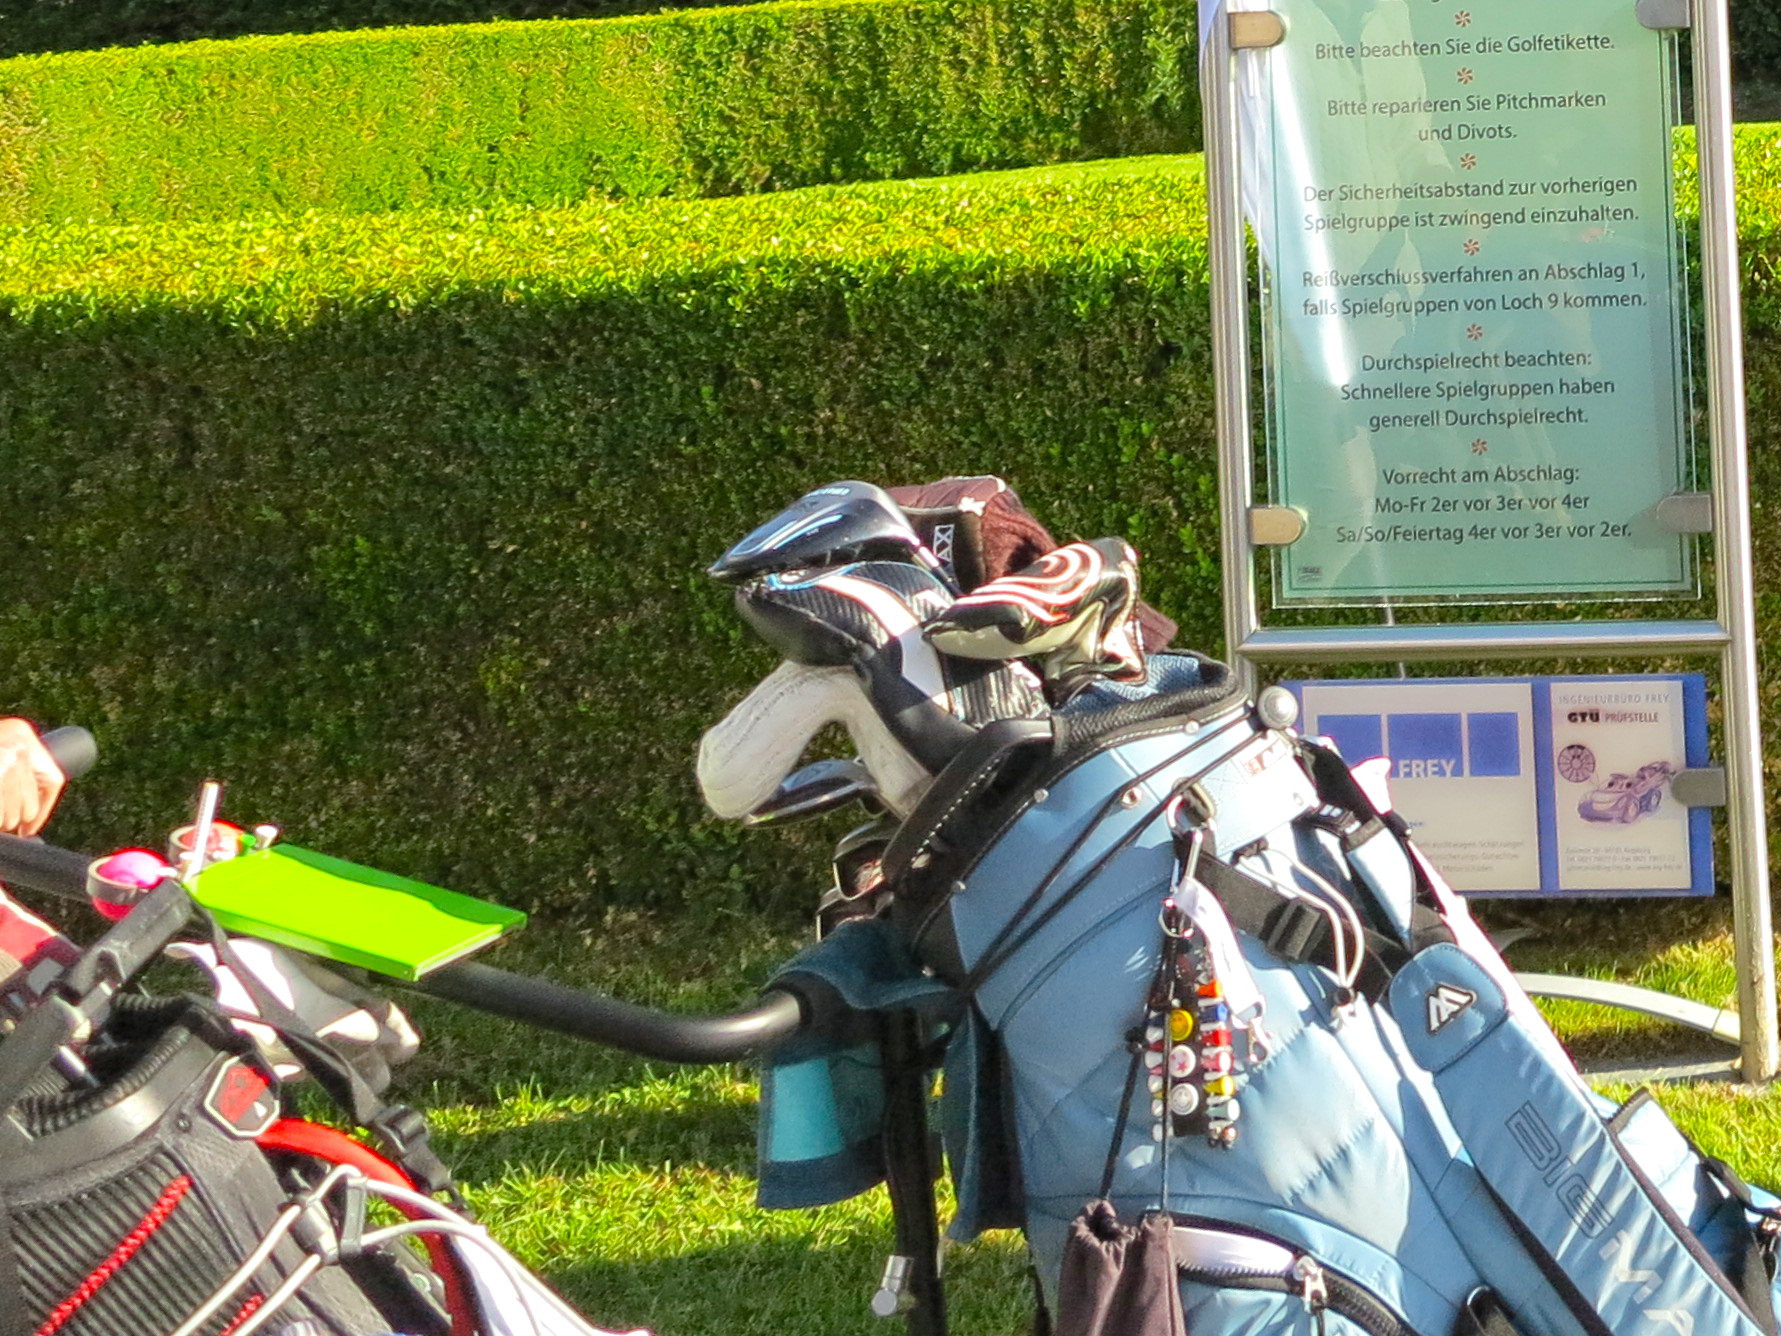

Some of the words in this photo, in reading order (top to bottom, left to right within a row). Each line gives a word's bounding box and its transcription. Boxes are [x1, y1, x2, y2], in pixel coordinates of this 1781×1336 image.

[1315, 42, 1355, 60] Bitte
[1359, 38, 1441, 58] beachten
[1445, 38, 1471, 55] Sie
[1475, 37, 1503, 54] die
[1507, 34, 1615, 53] Golfetikette.
[1327, 99, 1367, 116] Bitte
[1372, 96, 1461, 117] reparieren
[1466, 95, 1492, 112] Sie
[1496, 91, 1606, 111] Pitchmarken
[1418, 124, 1453, 142] und
[1458, 123, 1517, 140] Divots.
[1304, 185, 1334, 202] Der
[1338, 179, 1504, 201] Sicherheitsabstand
[1508, 181, 1537, 196] zur
[1541, 176, 1637, 197] vorherigen
[1304, 212, 1411, 235] Spielgruppe
[1415, 212, 1435, 228] ist
[1438, 208, 1526, 230] zwingend
[1531, 205, 1639, 225] einzuhalten.
[1303, 268, 1514, 288] Reißverschlussverfahren
[1518, 267, 1540, 282] an
[1544, 263, 1626, 285] Abschlag
[1631, 262, 1646, 281] 1,
[1303, 299, 1338, 316] falls
[1342, 295, 1460, 319] Spielgruppen
[1463, 296, 1498, 312] von
[1501, 292, 1544, 310] Loch
[1547, 293, 1559, 309] 9
[1563, 290, 1647, 309] kommen.
[1362, 352, 1501, 373] Durchspielrecht
[1504, 351, 1592, 367] beachten:
[1340, 382, 1433, 401] Schnellere
[1436, 380, 1555, 403] Spielgruppen
[1559, 378, 1615, 394] haben
[1369, 411, 1441, 432] generell
[1444, 408, 1589, 429] Durchspielrecht.
[1383, 467, 1457, 484] Vorrecht
[1461, 467, 1490, 483] am
[1494, 465, 1580, 486] Abschlag:
[1375, 496, 1427, 514] Mo-Fr
[1431, 496, 1459, 512] 2er
[1462, 496, 1492, 511] vor
[1496, 495, 1525, 511] 3er
[1529, 495, 1558, 510] vor
[1561, 494, 1589, 510] 4er
[1336, 525, 1464, 545] Sa/So/Feiertag
[1468, 523, 1497, 540] 4er
[1500, 523, 1531, 539] vor
[1534, 523, 1564, 539] 3er
[1567, 523, 1597, 538] vor
[1600, 521, 1632, 538] 2er.
[1567, 709, 1600, 723] GTÜ
[1604, 711, 1659, 723] PRÜFSTELLE
[1398, 759, 1456, 778] FREY
[1504, 1100, 1614, 1240] BIG
